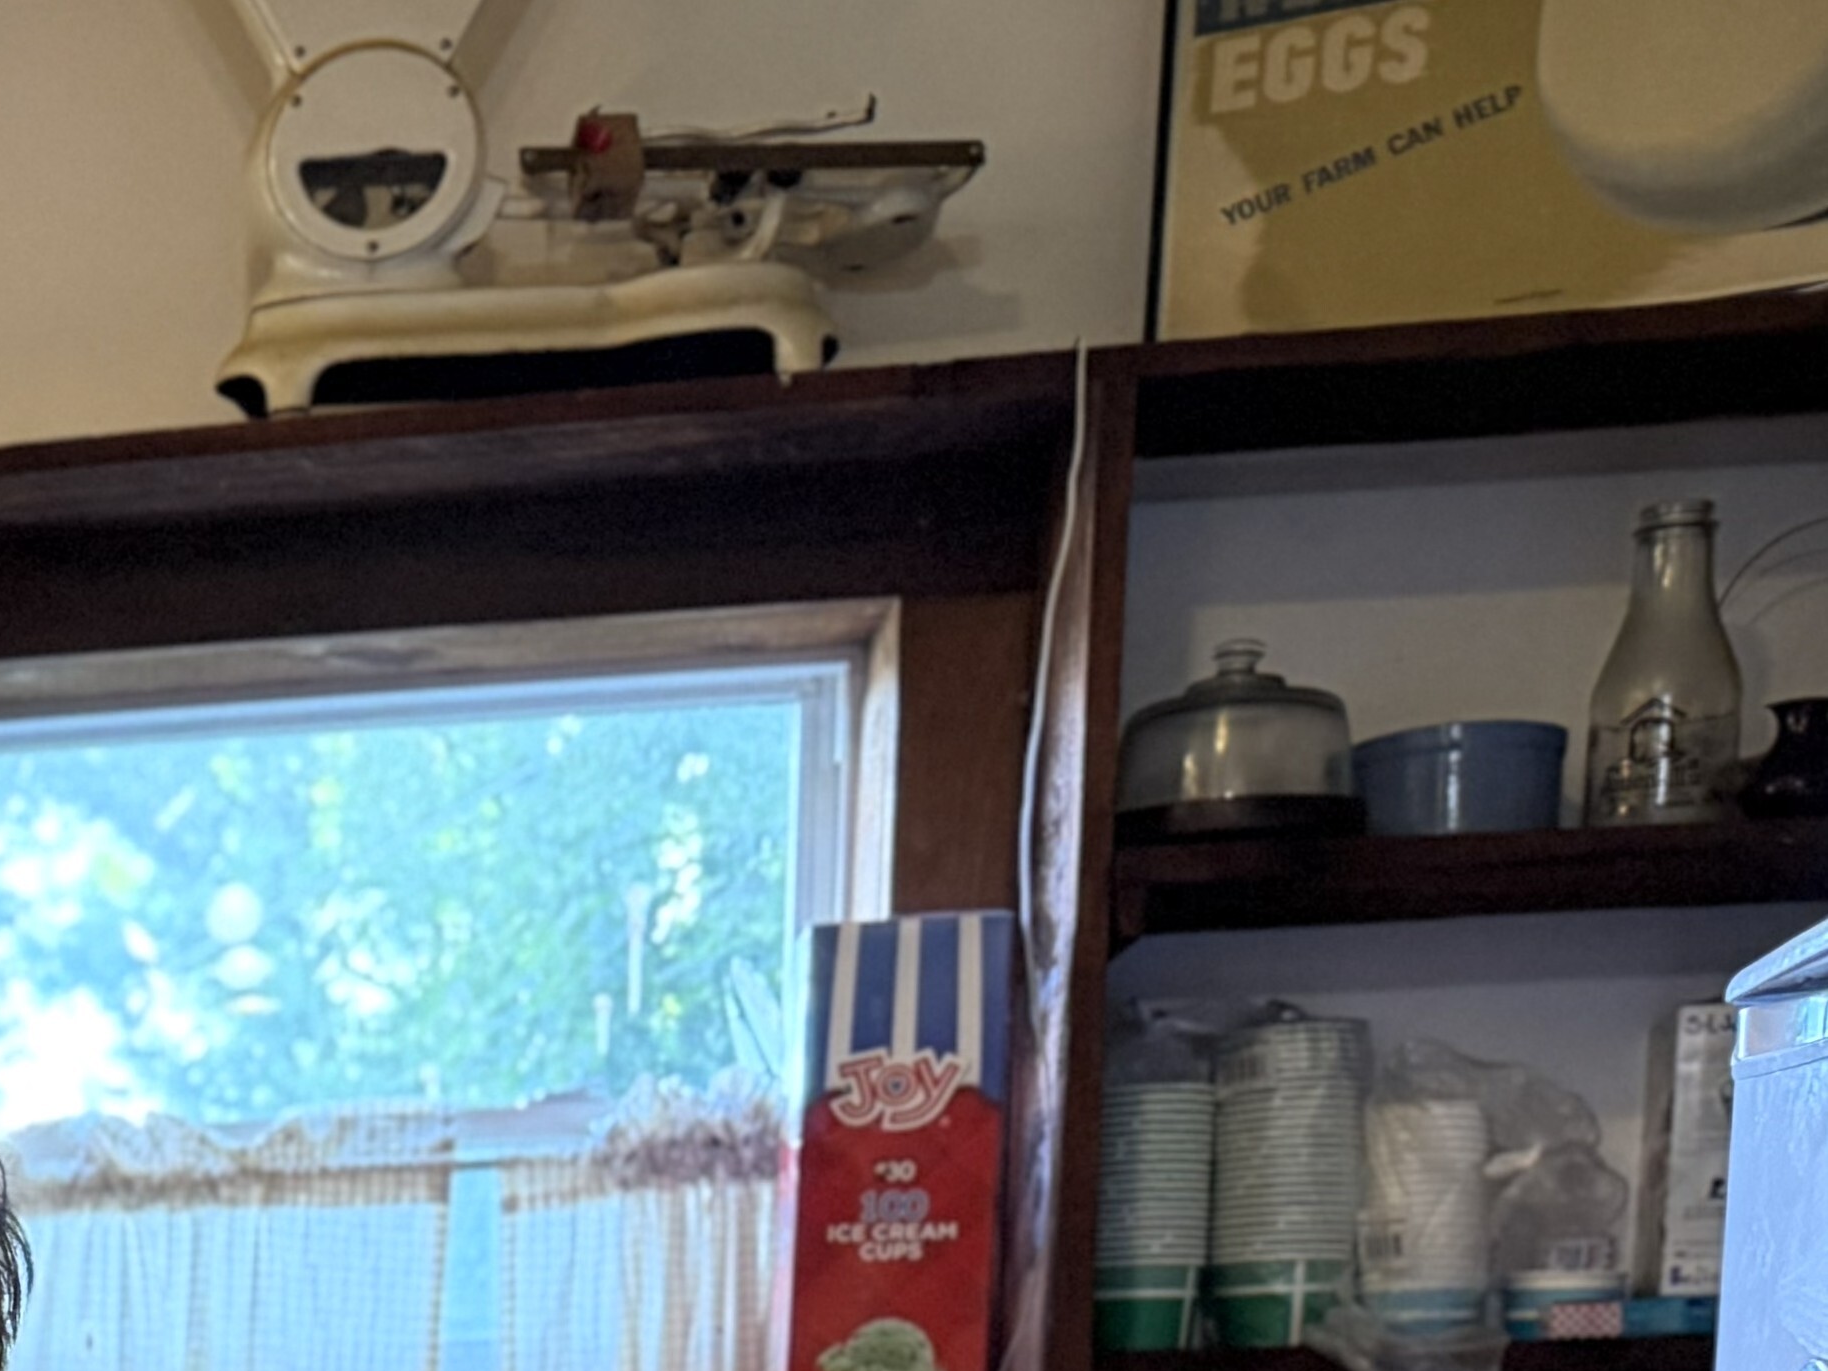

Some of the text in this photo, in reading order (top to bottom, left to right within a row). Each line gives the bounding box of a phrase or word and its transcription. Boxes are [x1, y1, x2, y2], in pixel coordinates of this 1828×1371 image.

[1210, 8, 1430, 116] EGGS
[1219, 84, 1523, 227] YOUR FARM CAN HELP
[835, 1050, 963, 1128] JOY
[826, 1221, 959, 1243] ICE CREAM
[858, 1241, 925, 1262] CUPS
